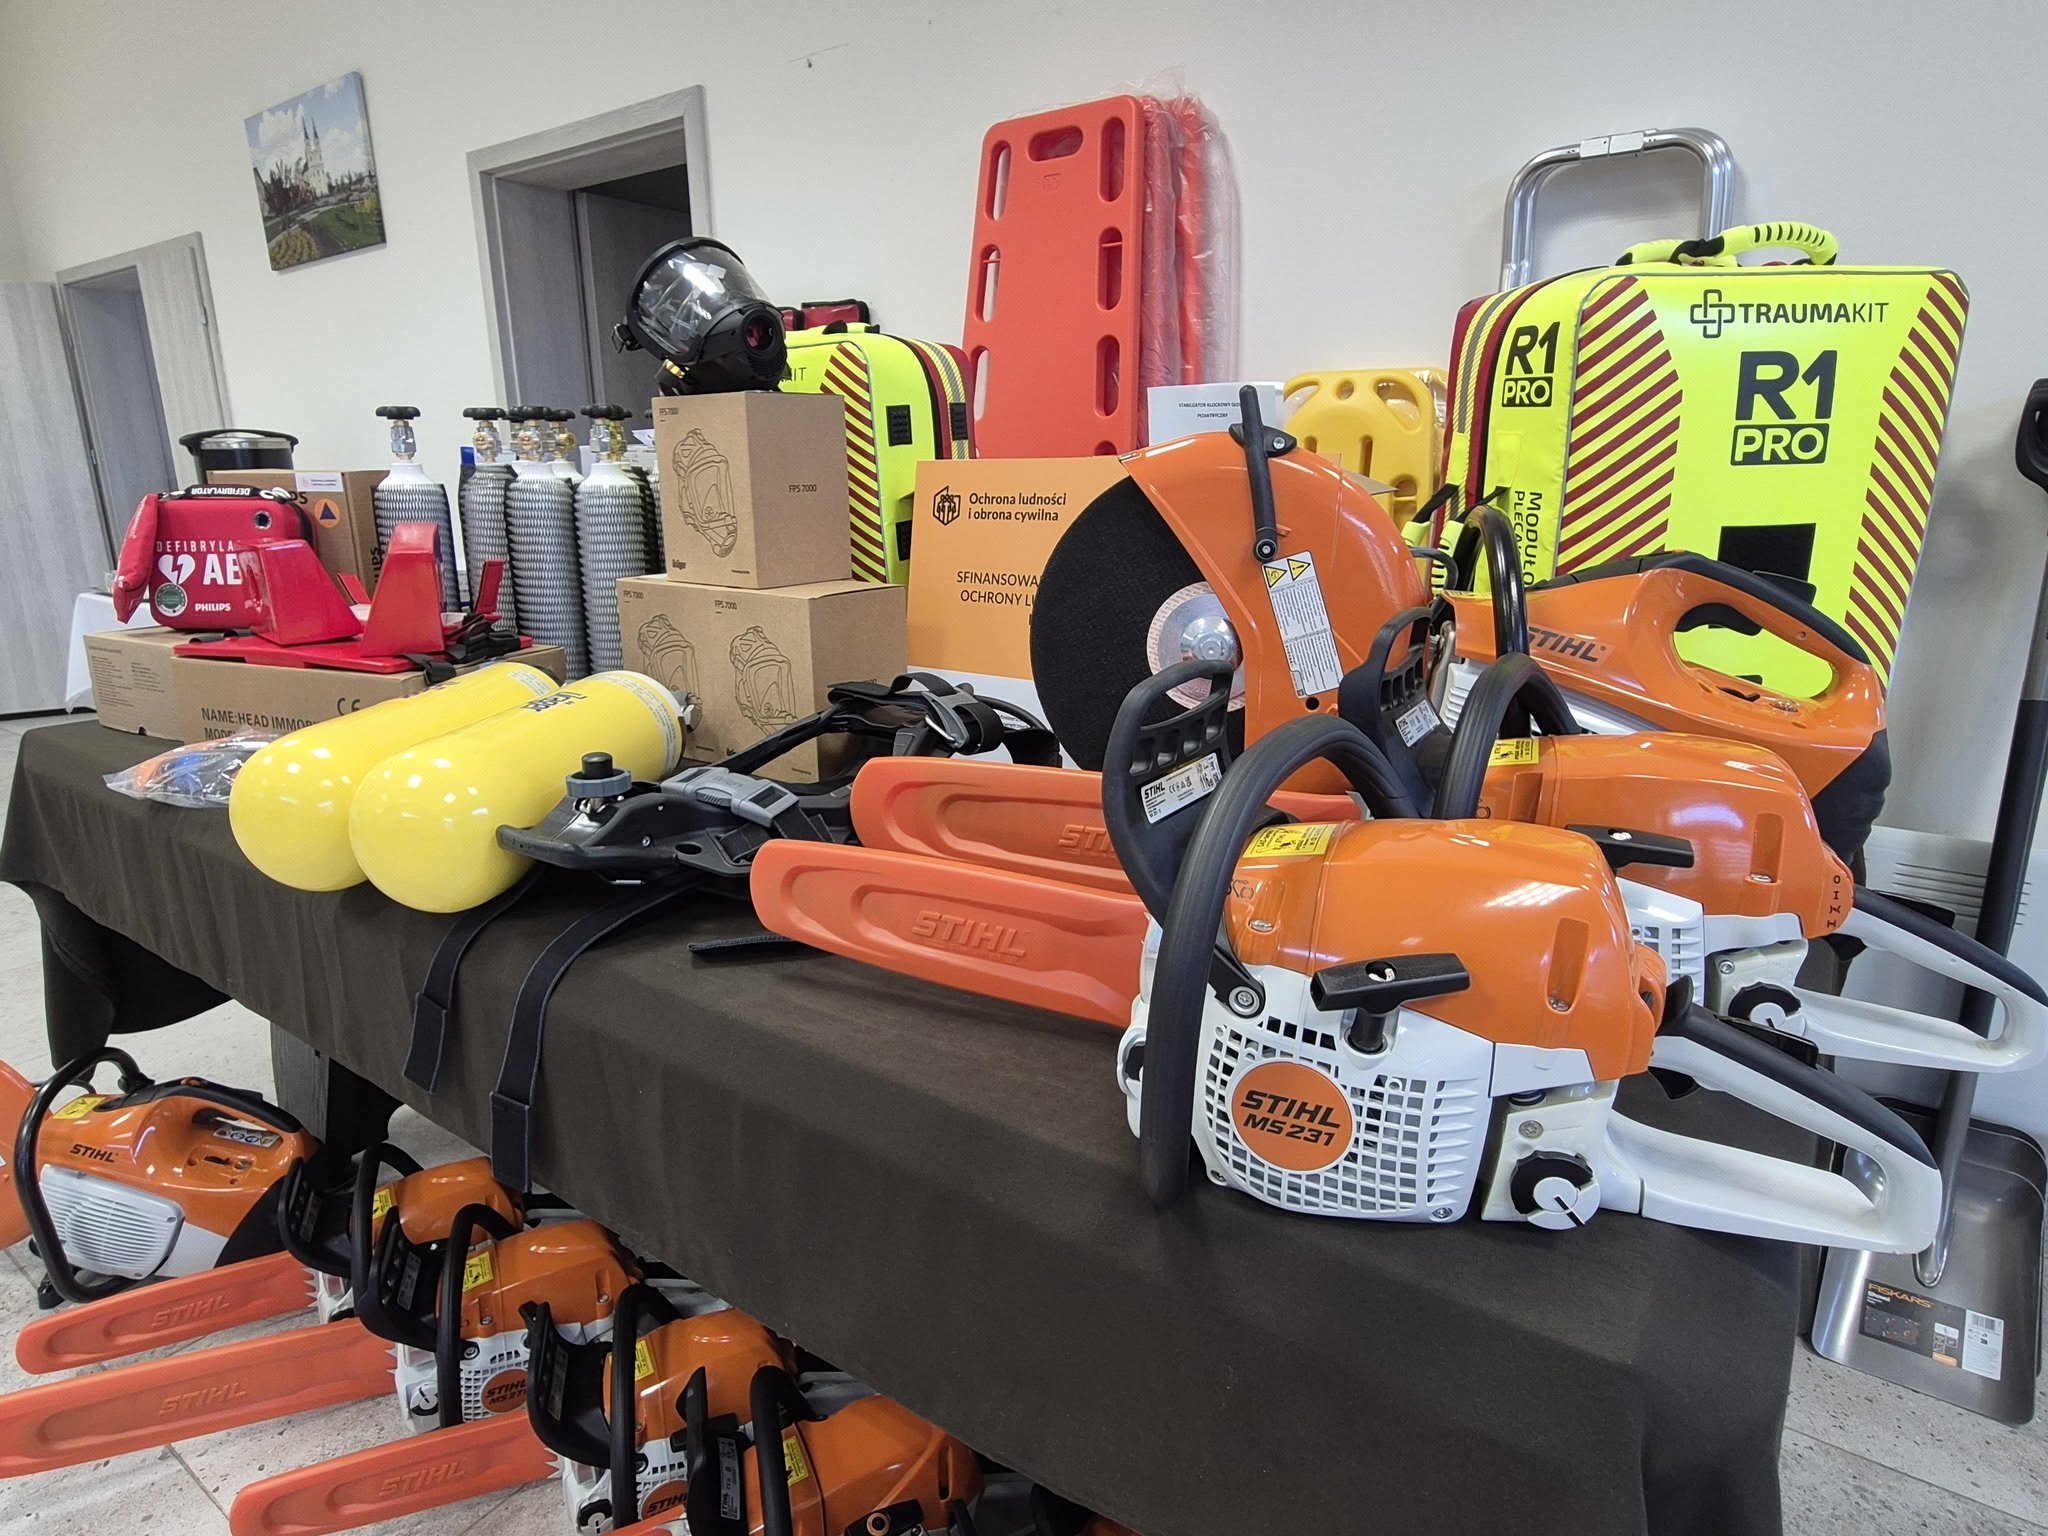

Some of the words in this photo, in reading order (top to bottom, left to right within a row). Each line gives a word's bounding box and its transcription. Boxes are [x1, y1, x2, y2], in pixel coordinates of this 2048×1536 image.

[1739, 302, 1890, 324] TRAUMAKIT
[1505, 321, 1561, 376] R1
[1502, 378, 1552, 406] PRO
[1735, 349, 1838, 421] R1
[1733, 426, 1826, 462] PRO
[190, 487, 251, 497] DEFIBRYLATOR
[789, 485, 801, 493] FPS
[802, 484, 817, 492] 7000
[969, 492, 1016, 505] Ochrona
[1018, 492, 1067, 506] ludności
[968, 507, 972, 520] i
[973, 508, 1012, 521] obrona
[1014, 508, 1059, 523] cywilna
[156, 539, 235, 553] DEFIBRYLA
[956, 571, 1041, 588] SFINANSOWA
[623, 590, 633, 599] FPS
[633, 591, 645, 600] 7000
[714, 600, 725, 609] FPS
[726, 601, 738, 611] 7000
[960, 589, 1023, 606] OCHRONY
[194, 602, 232, 612] PHILIPS
[1144, 781, 1166, 800] STIHL
[1058, 824, 1115, 852] STI
[911, 910, 1026, 957] STIHL
[1240, 1089, 1341, 1129] STIHL
[69, 1143, 115, 1163] STIHL
[1868, 1282, 1932, 1309] FISKARS
[151, 1295, 231, 1327] STIHL
[159, 1382, 247, 1416] STIHL
[378, 1459, 465, 1497] STIHL
[647, 1491, 688, 1514] STIH
